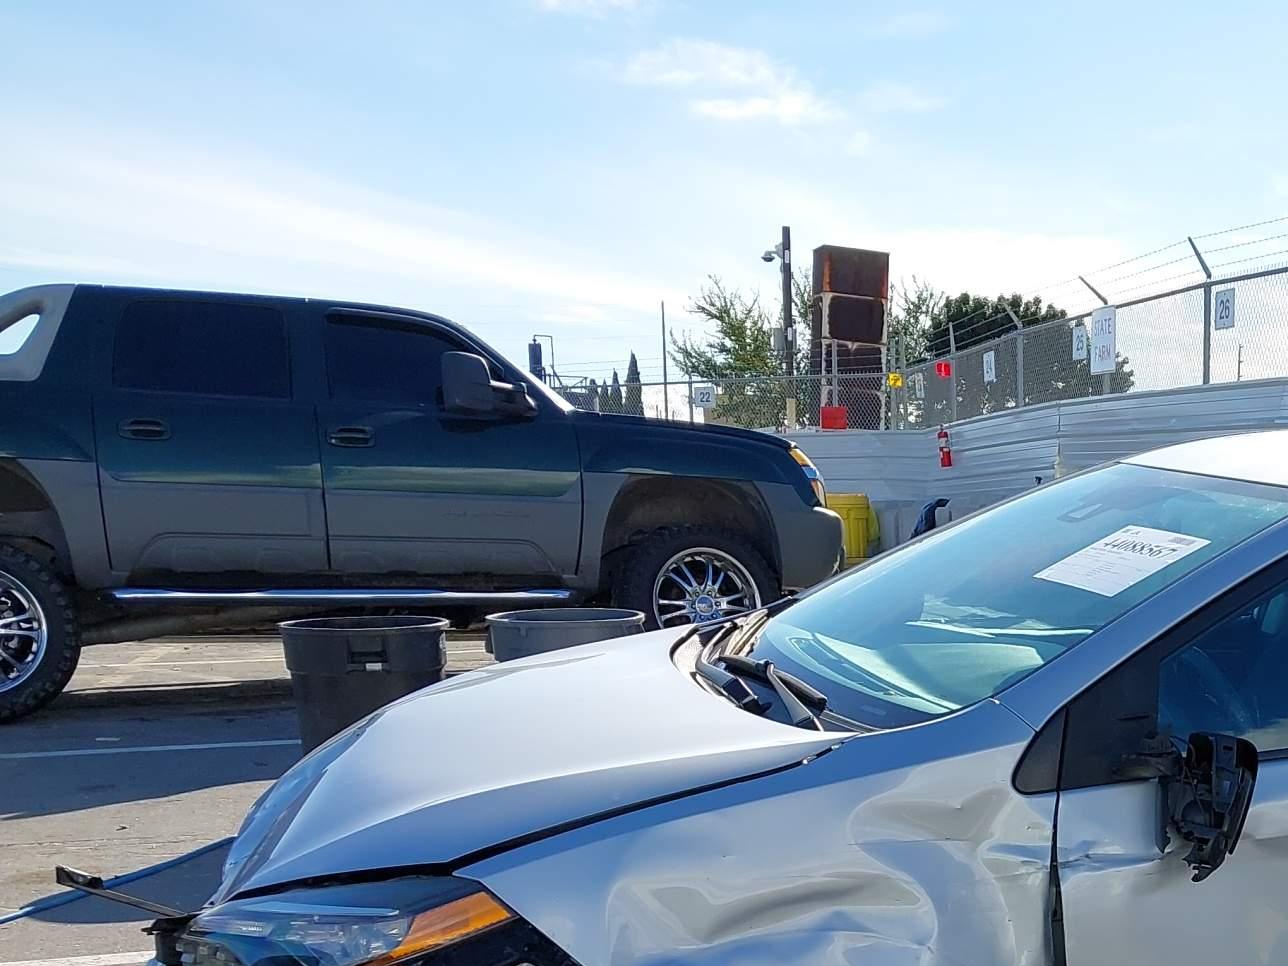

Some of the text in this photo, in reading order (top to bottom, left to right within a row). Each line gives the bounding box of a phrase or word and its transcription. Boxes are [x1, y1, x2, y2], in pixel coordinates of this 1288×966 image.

[1219, 298, 1231, 320] 26
[1094, 317, 1112, 337] STATE
[1076, 333, 1084, 352] 25
[1094, 343, 1111, 362] FARM
[699, 391, 711, 403] 22
[1103, 537, 1179, 559] 44088567
